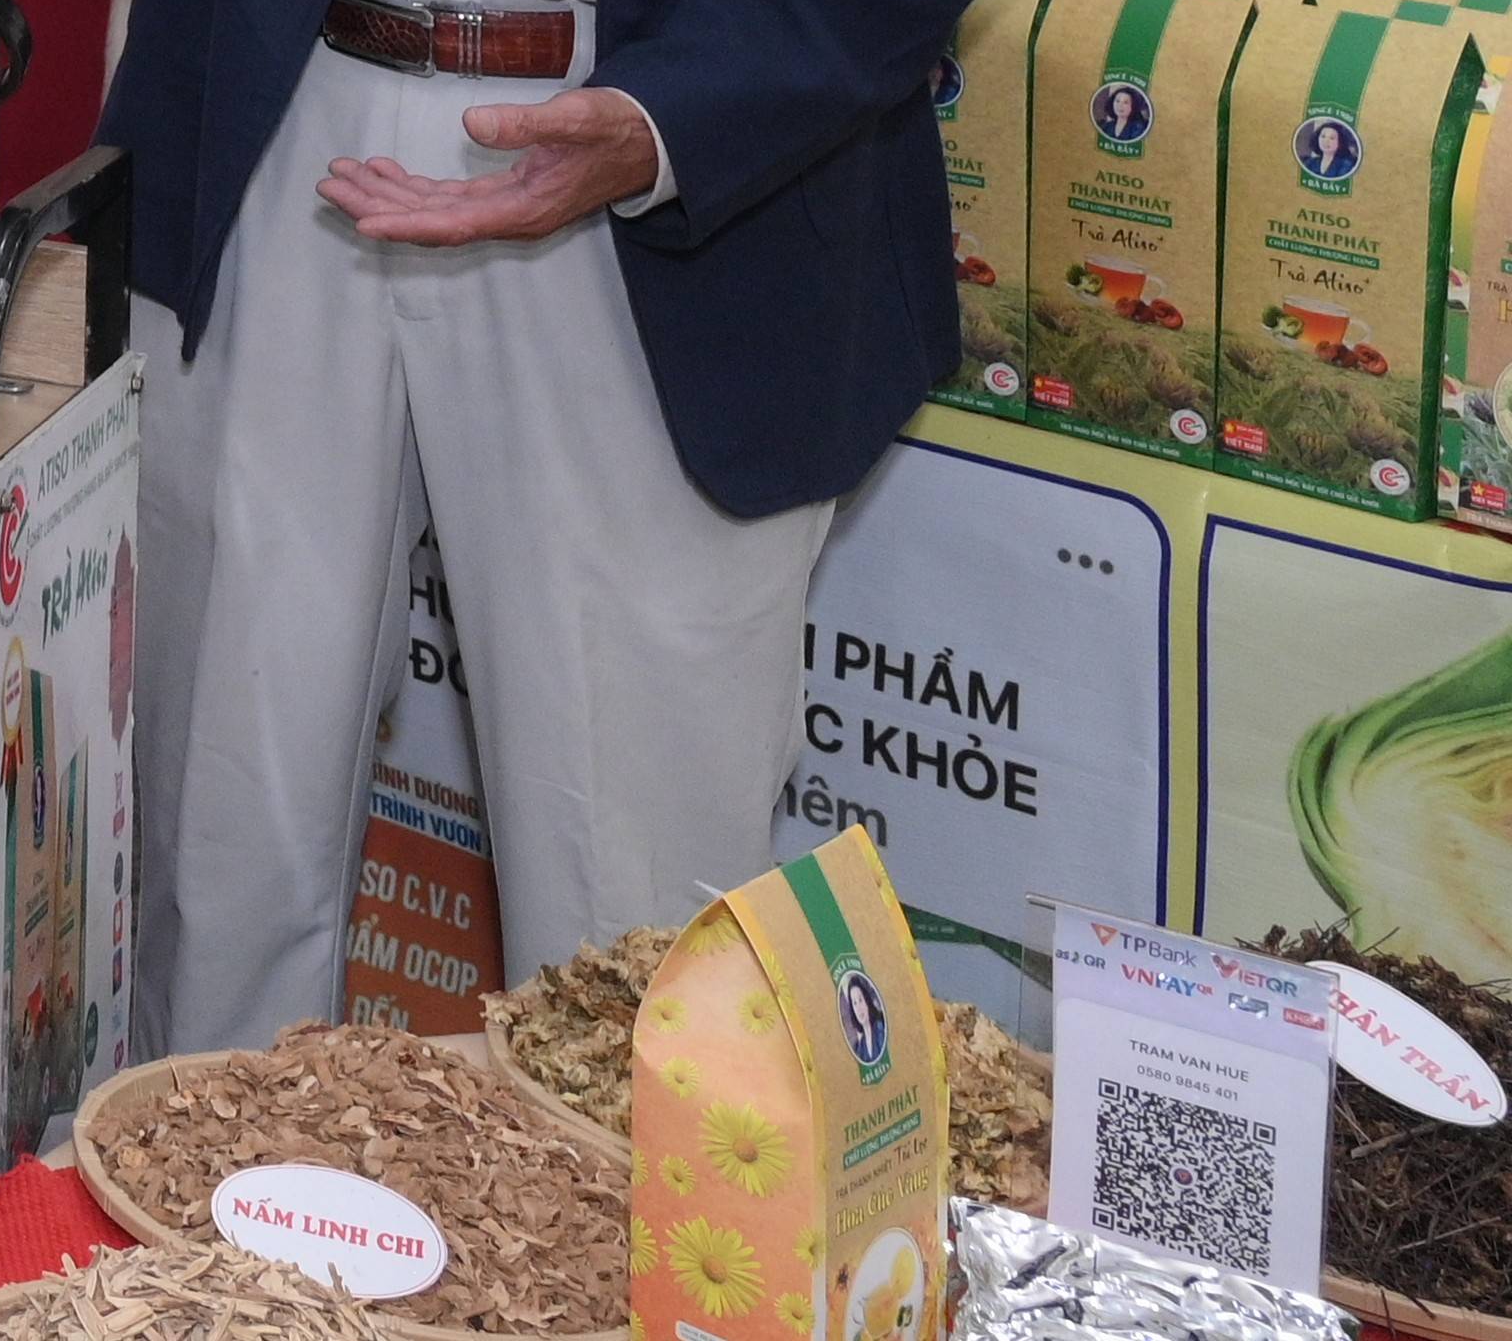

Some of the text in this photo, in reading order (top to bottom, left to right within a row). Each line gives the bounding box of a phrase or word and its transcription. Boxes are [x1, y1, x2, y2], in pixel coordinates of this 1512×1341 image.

[1095, 170, 1144, 190] ATISO
[1297, 208, 1351, 229] ATISO
[834, 646, 1020, 731] PHẨM
[862, 718, 1038, 817] KHỎE
[402, 872, 473, 930] C.V.C
[1084, 953, 1106, 969] QR
[1120, 932, 1198, 967] TPBank
[1130, 1039, 1250, 1083] TRAM VAN HUE
[1329, 989, 1400, 1046] HÂN
[1400, 1046, 1491, 1111] TRẦN
[1137, 1065, 1172, 1083] 0580
[1215, 1086, 1238, 1101] 401
[232, 1196, 426, 1259] NẤM LINH CHI
